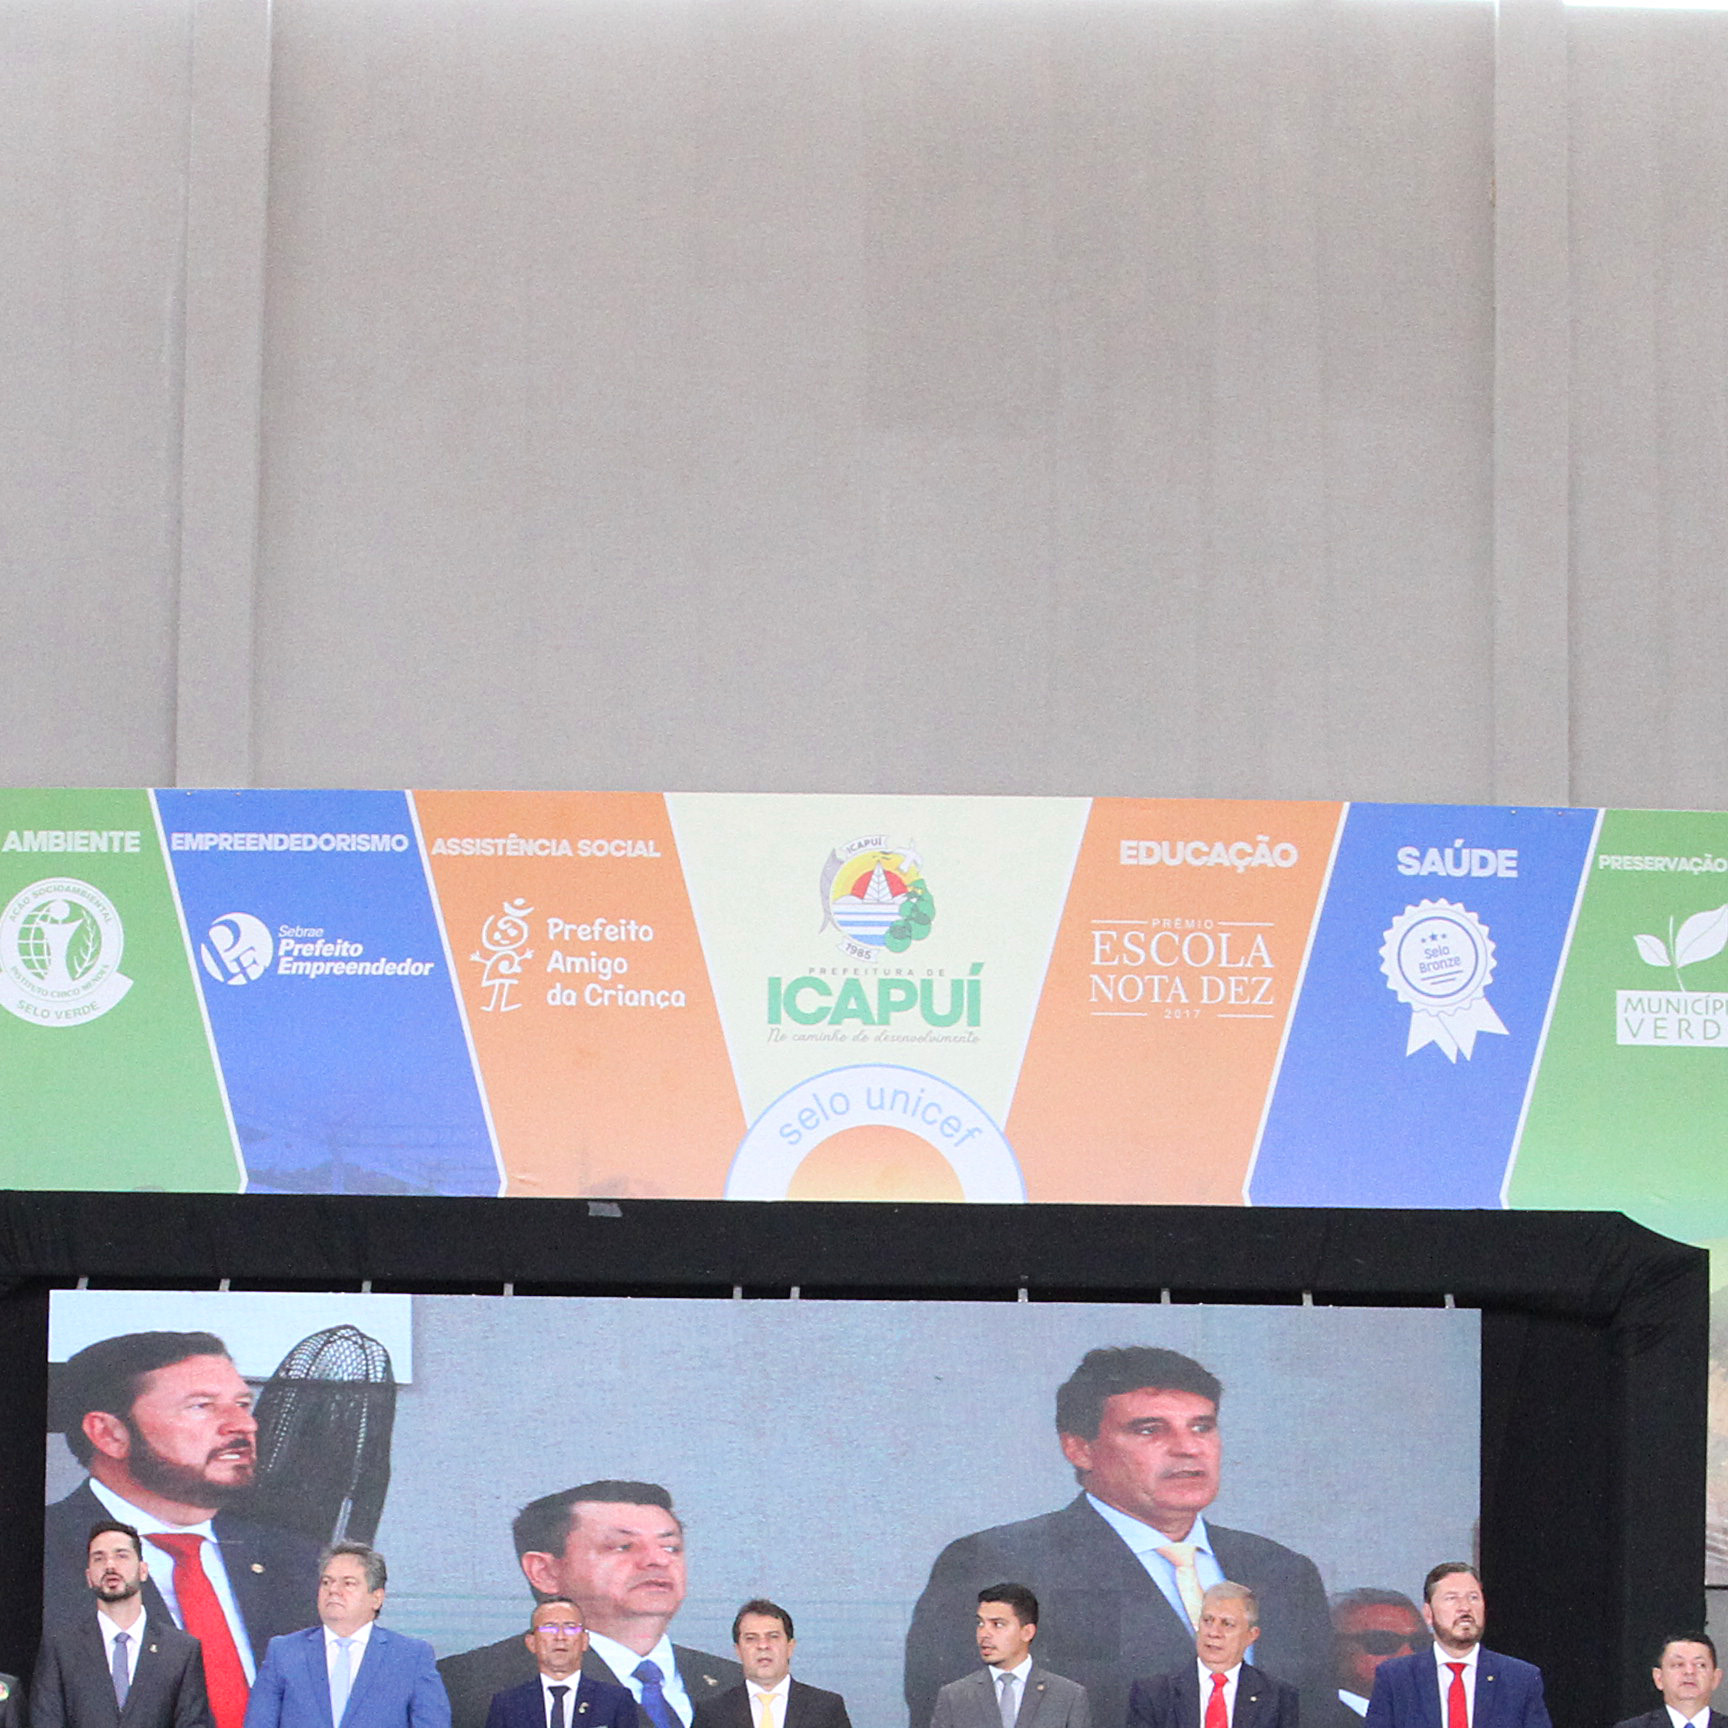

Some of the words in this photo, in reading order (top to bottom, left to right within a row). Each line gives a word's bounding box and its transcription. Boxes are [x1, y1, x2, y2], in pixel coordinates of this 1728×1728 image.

[2, 830, 141, 853] AMBIENTE
[171, 832, 409, 852] EMPREENDEDORISMO
[431, 833, 573, 856] ASSISTÊNCIA
[577, 840, 662, 858] SOCIAL
[846, 837, 882, 854] ICAPUÍ
[1120, 834, 1299, 872] EDUCAÇÃO
[1397, 838, 1519, 878] SAÚDE
[1598, 853, 1728, 875] PRESERVAÇÃO
[278, 925, 325, 938] Sebrae
[546, 917, 654, 942] Prefeito
[278, 939, 364, 958] Prefeito
[845, 943, 872, 960] 1985
[1091, 930, 1275, 968] ESCOLA
[1424, 945, 1450, 960] Selo
[277, 958, 435, 979] Empreendedor
[546, 950, 628, 981] Amigo
[808, 967, 915, 977] PREFEITURA
[926, 968, 946, 977] DE
[1418, 955, 1462, 974] Bronze
[546, 983, 577, 1007] da
[583, 983, 686, 1009] Criança
[767, 962, 985, 1028] ICAPUÍ
[1089, 974, 1189, 1004] NOTA
[1200, 976, 1274, 1005] DEZ
[16, 999, 51, 1019] SELO
[53, 1000, 101, 1019] VERDE
[1164, 1009, 1202, 1019] 2017
[779, 1092, 851, 1145] selo
[865, 1087, 983, 1148] unicef
